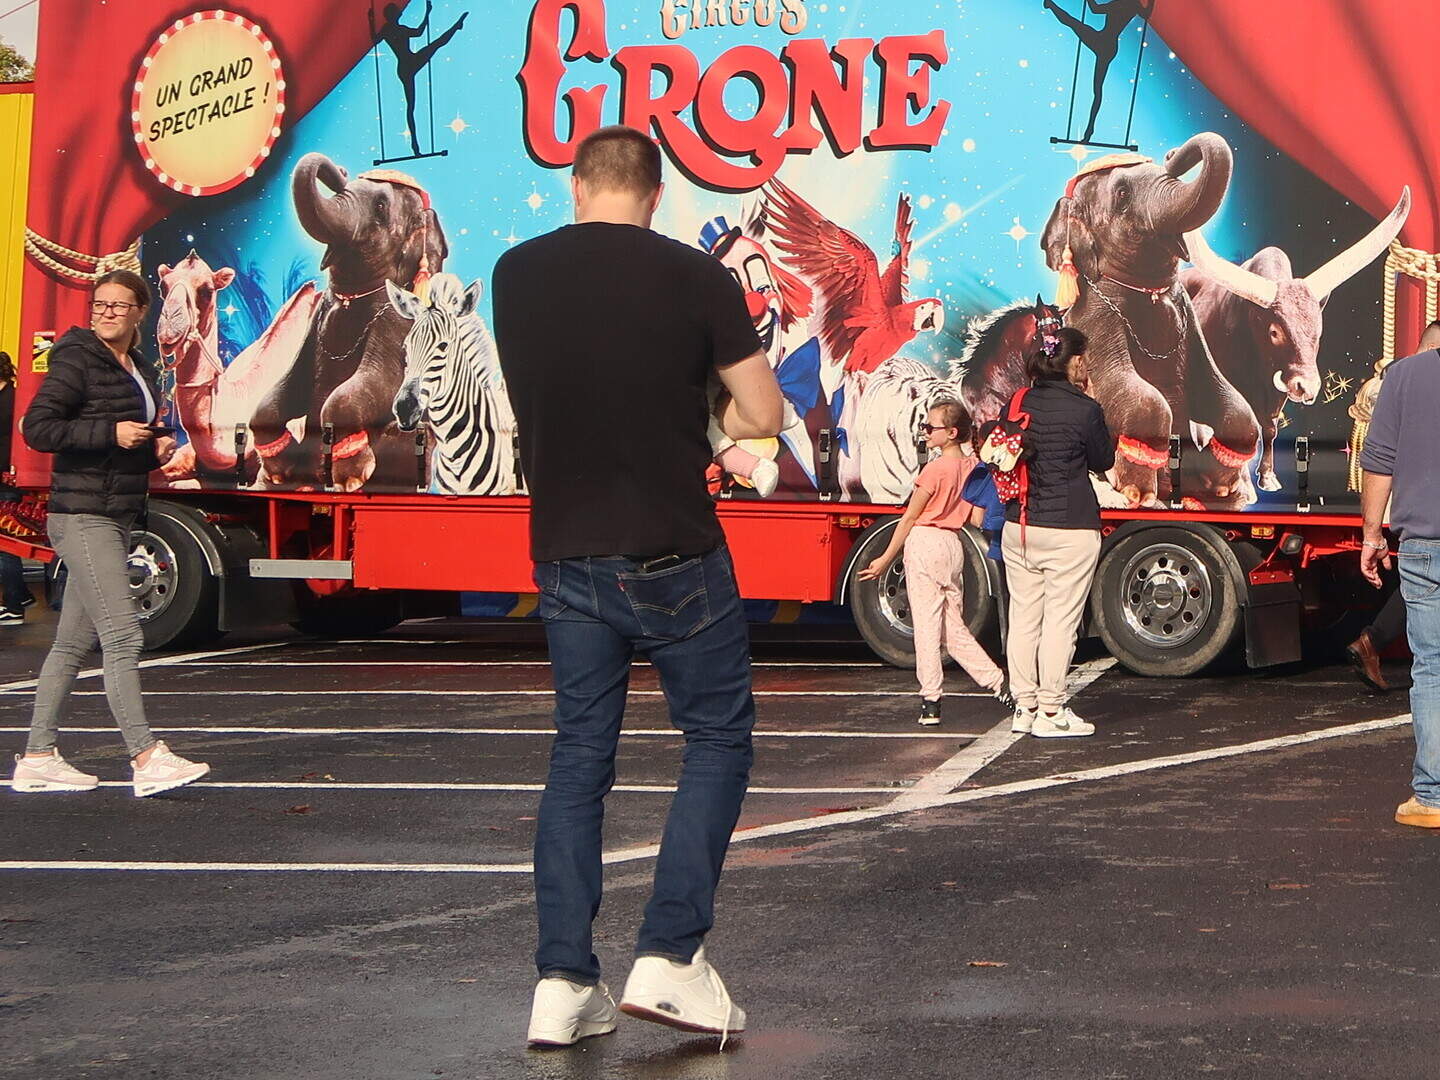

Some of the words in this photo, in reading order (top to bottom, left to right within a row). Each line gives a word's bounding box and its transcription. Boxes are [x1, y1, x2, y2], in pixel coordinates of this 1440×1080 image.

[156, 80, 182, 108] UN
[189, 56, 253, 97] GRAND
[149, 86, 256, 142] SPECTACLE
